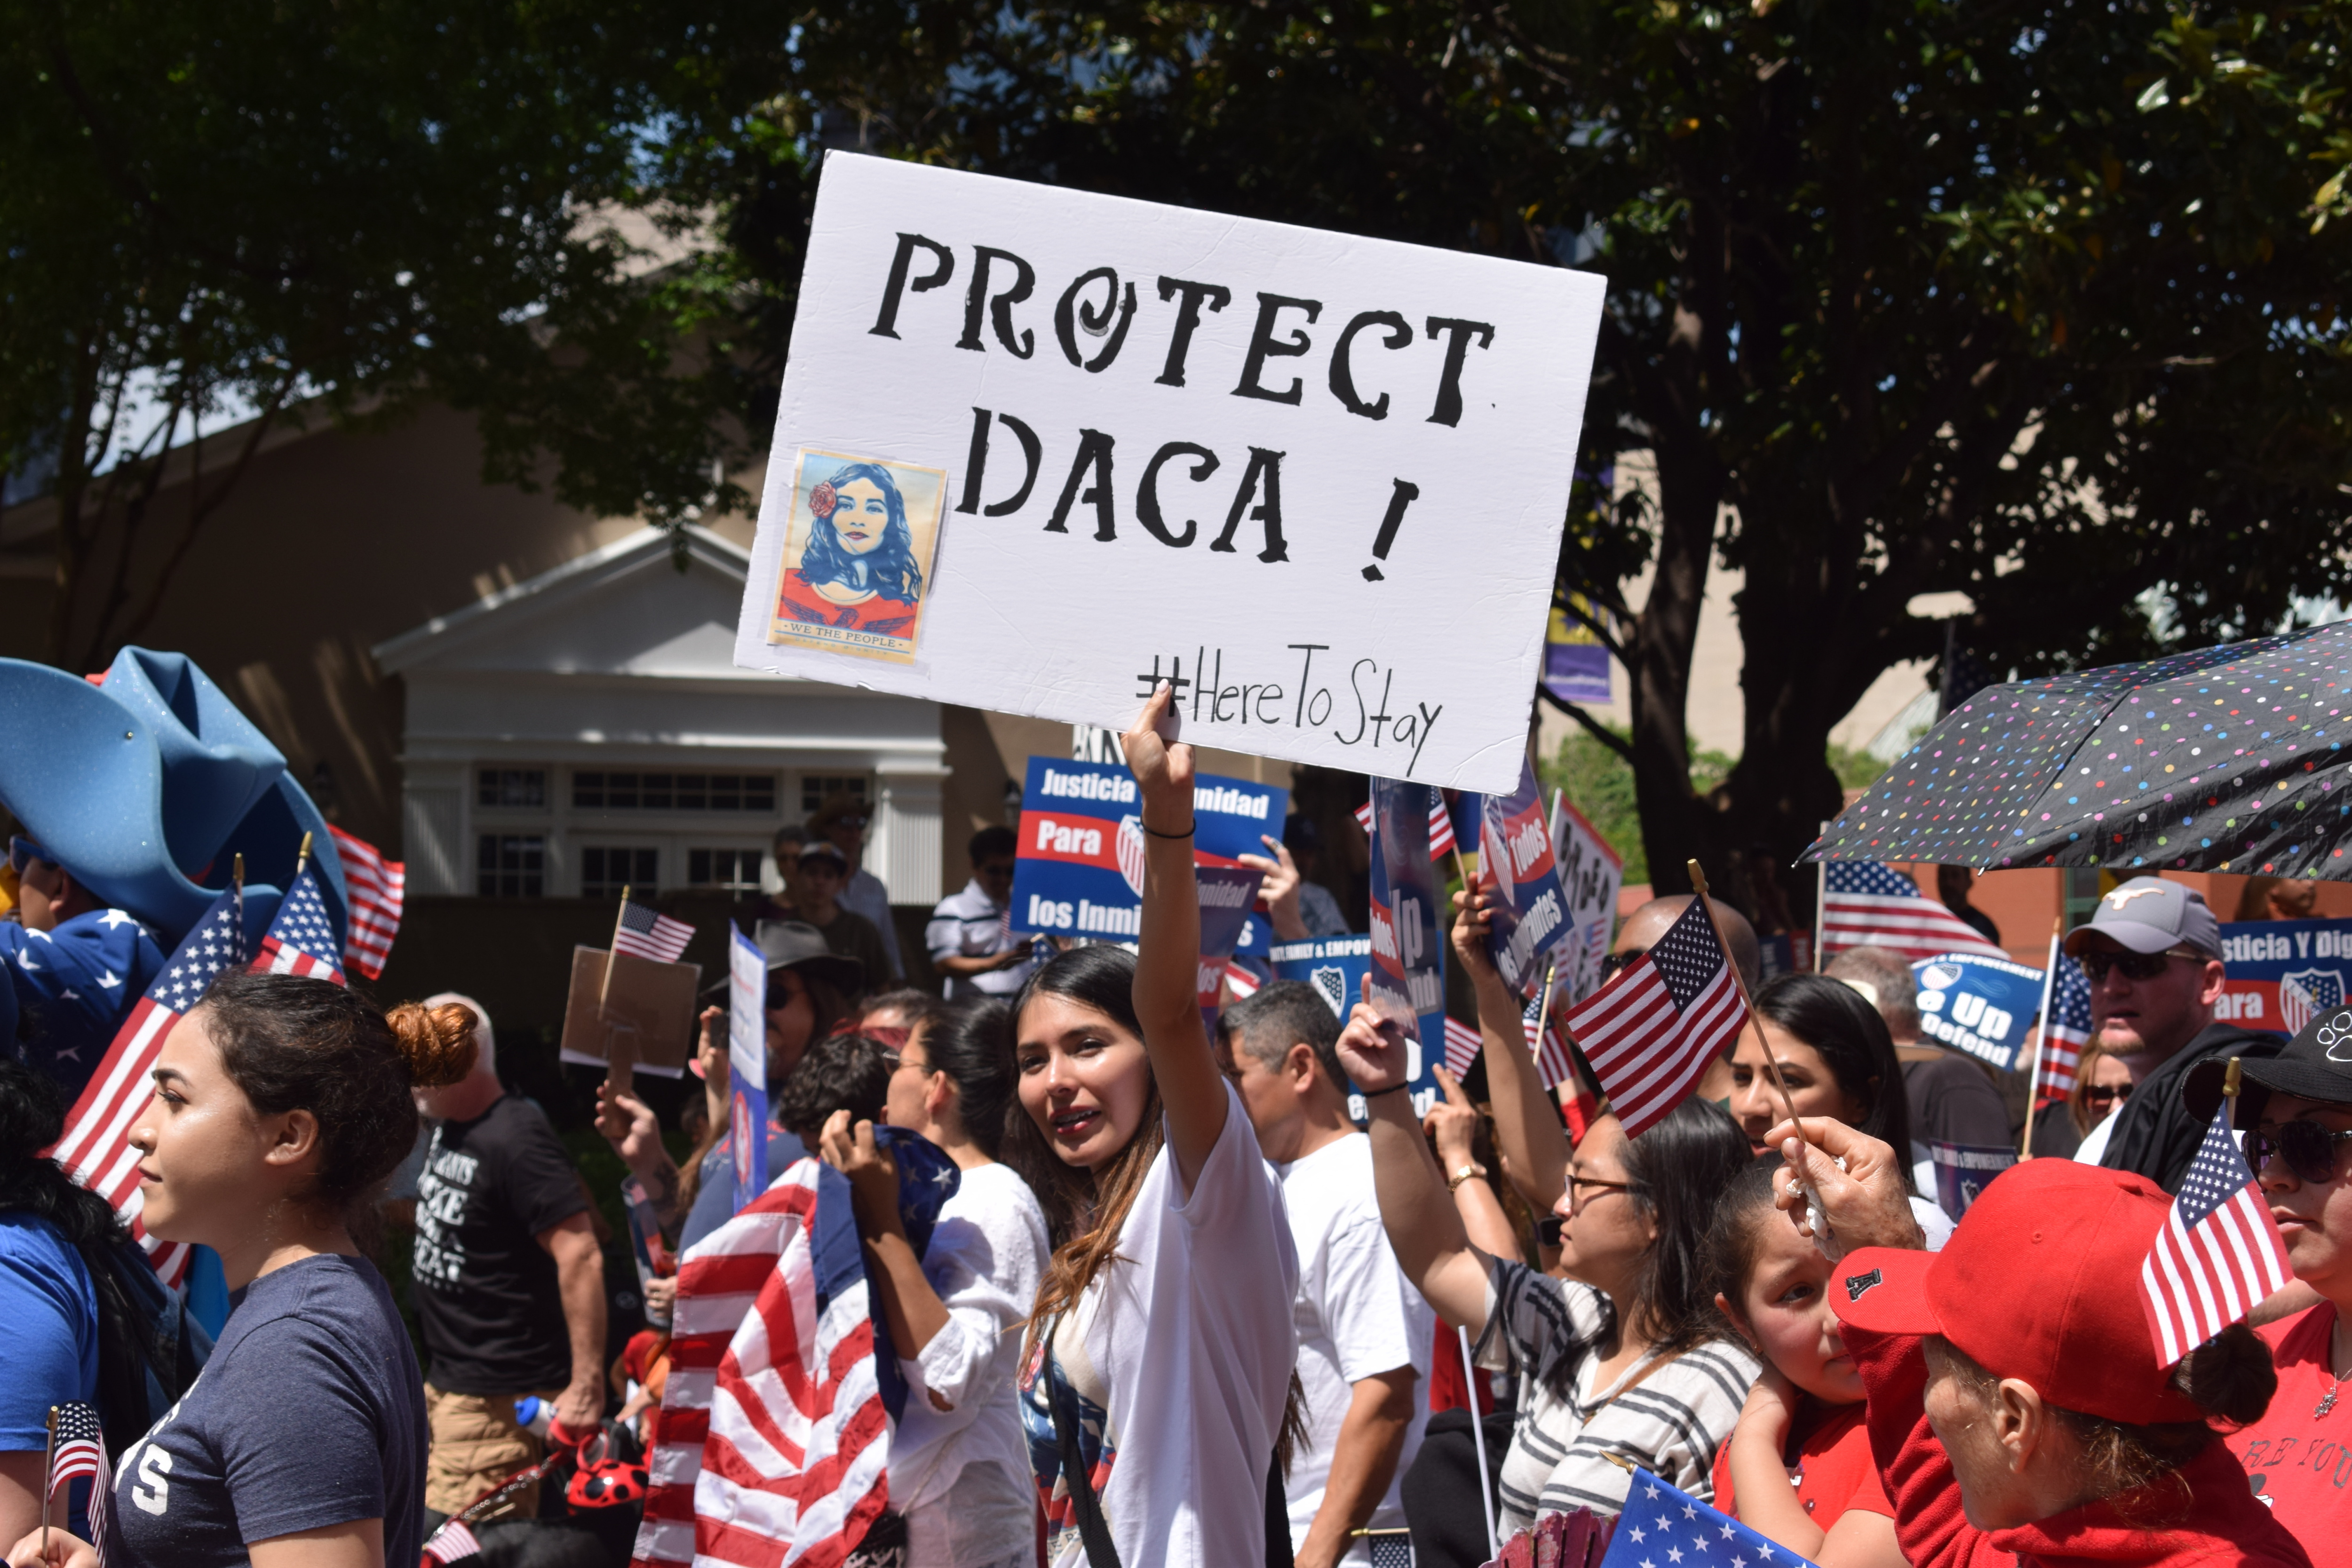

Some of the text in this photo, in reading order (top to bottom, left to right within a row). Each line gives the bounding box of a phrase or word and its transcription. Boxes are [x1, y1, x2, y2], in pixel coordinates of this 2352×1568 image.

[868, 232, 1494, 428] PROTECT
[955, 407, 1290, 563] DACA
[791, 623, 896, 648] WE THE PEOPLE
[1041, 768, 1269, 820] Justicia nidad
[1037, 820, 1102, 856] Para
[1510, 818, 1547, 877] Todos
[1028, 894, 1074, 929] los
[1315, 944, 1325, 958] &
[1326, 939, 1371, 958] EMPOW
[2221, 930, 2352, 963] sticia Y Dig
[1951, 991, 2013, 1041] Up
[2214, 992, 2264, 1020] ara
[1921, 1012, 2012, 1067] Defend
[1845, 1268, 1883, 1303] A
[2240, 1438, 2297, 1468] RE
